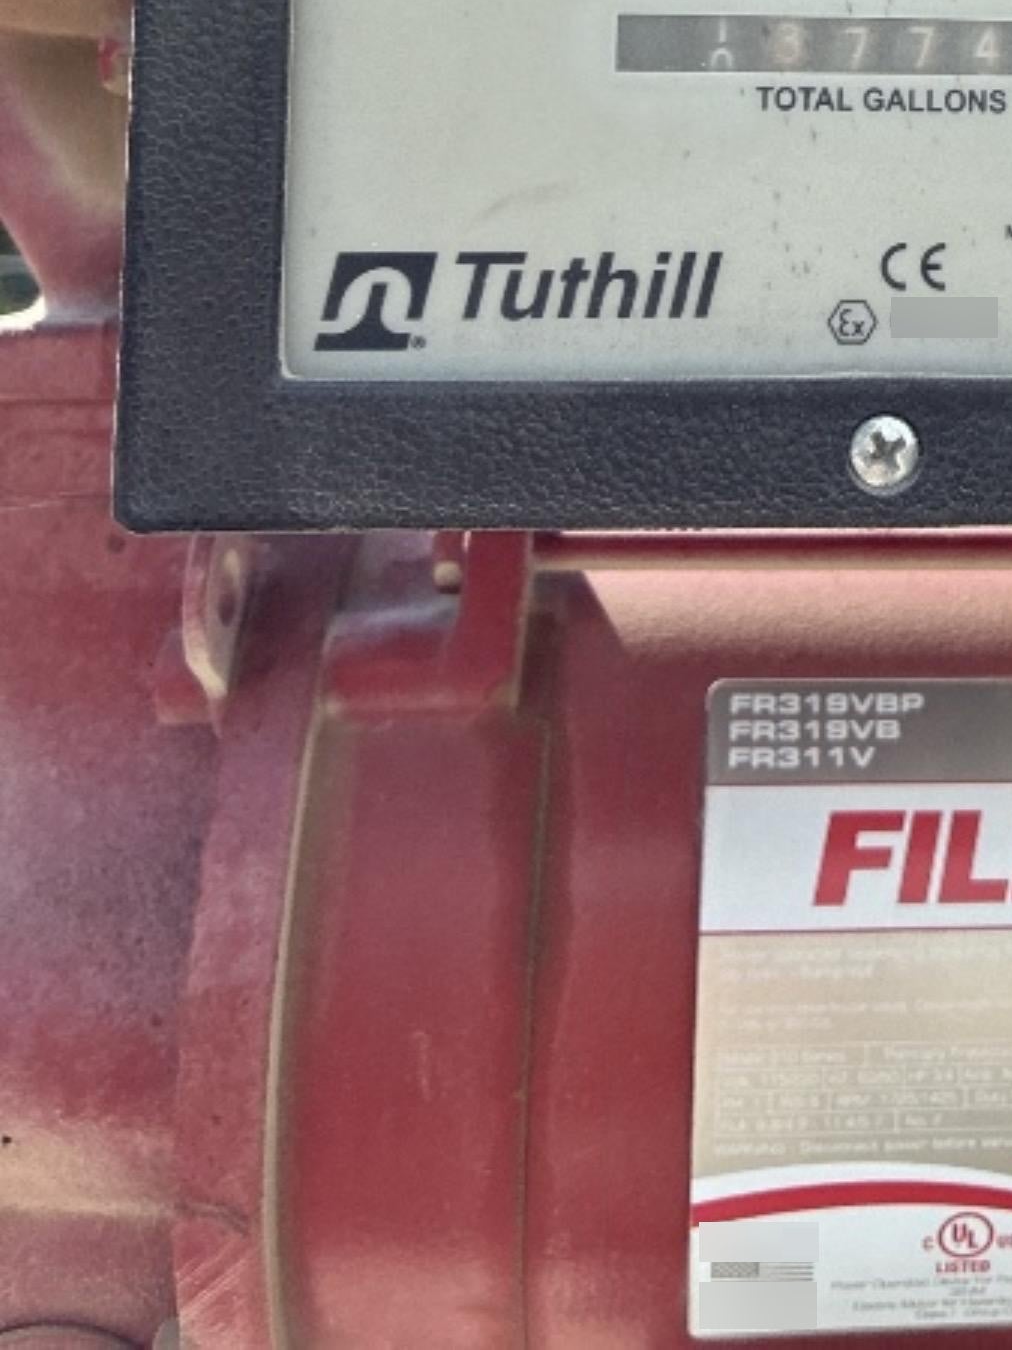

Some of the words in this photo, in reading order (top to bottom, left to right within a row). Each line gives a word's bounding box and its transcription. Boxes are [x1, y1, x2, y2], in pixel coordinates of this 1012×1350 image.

[757, 86, 852, 112] TOTAL
[862, 88, 1006, 114] GALLONS
[880, 242, 946, 291] CE
[456, 252, 723, 318] Tuthill
[728, 746, 876, 769] FR311V
[936, 1259, 991, 1272] LISTED
